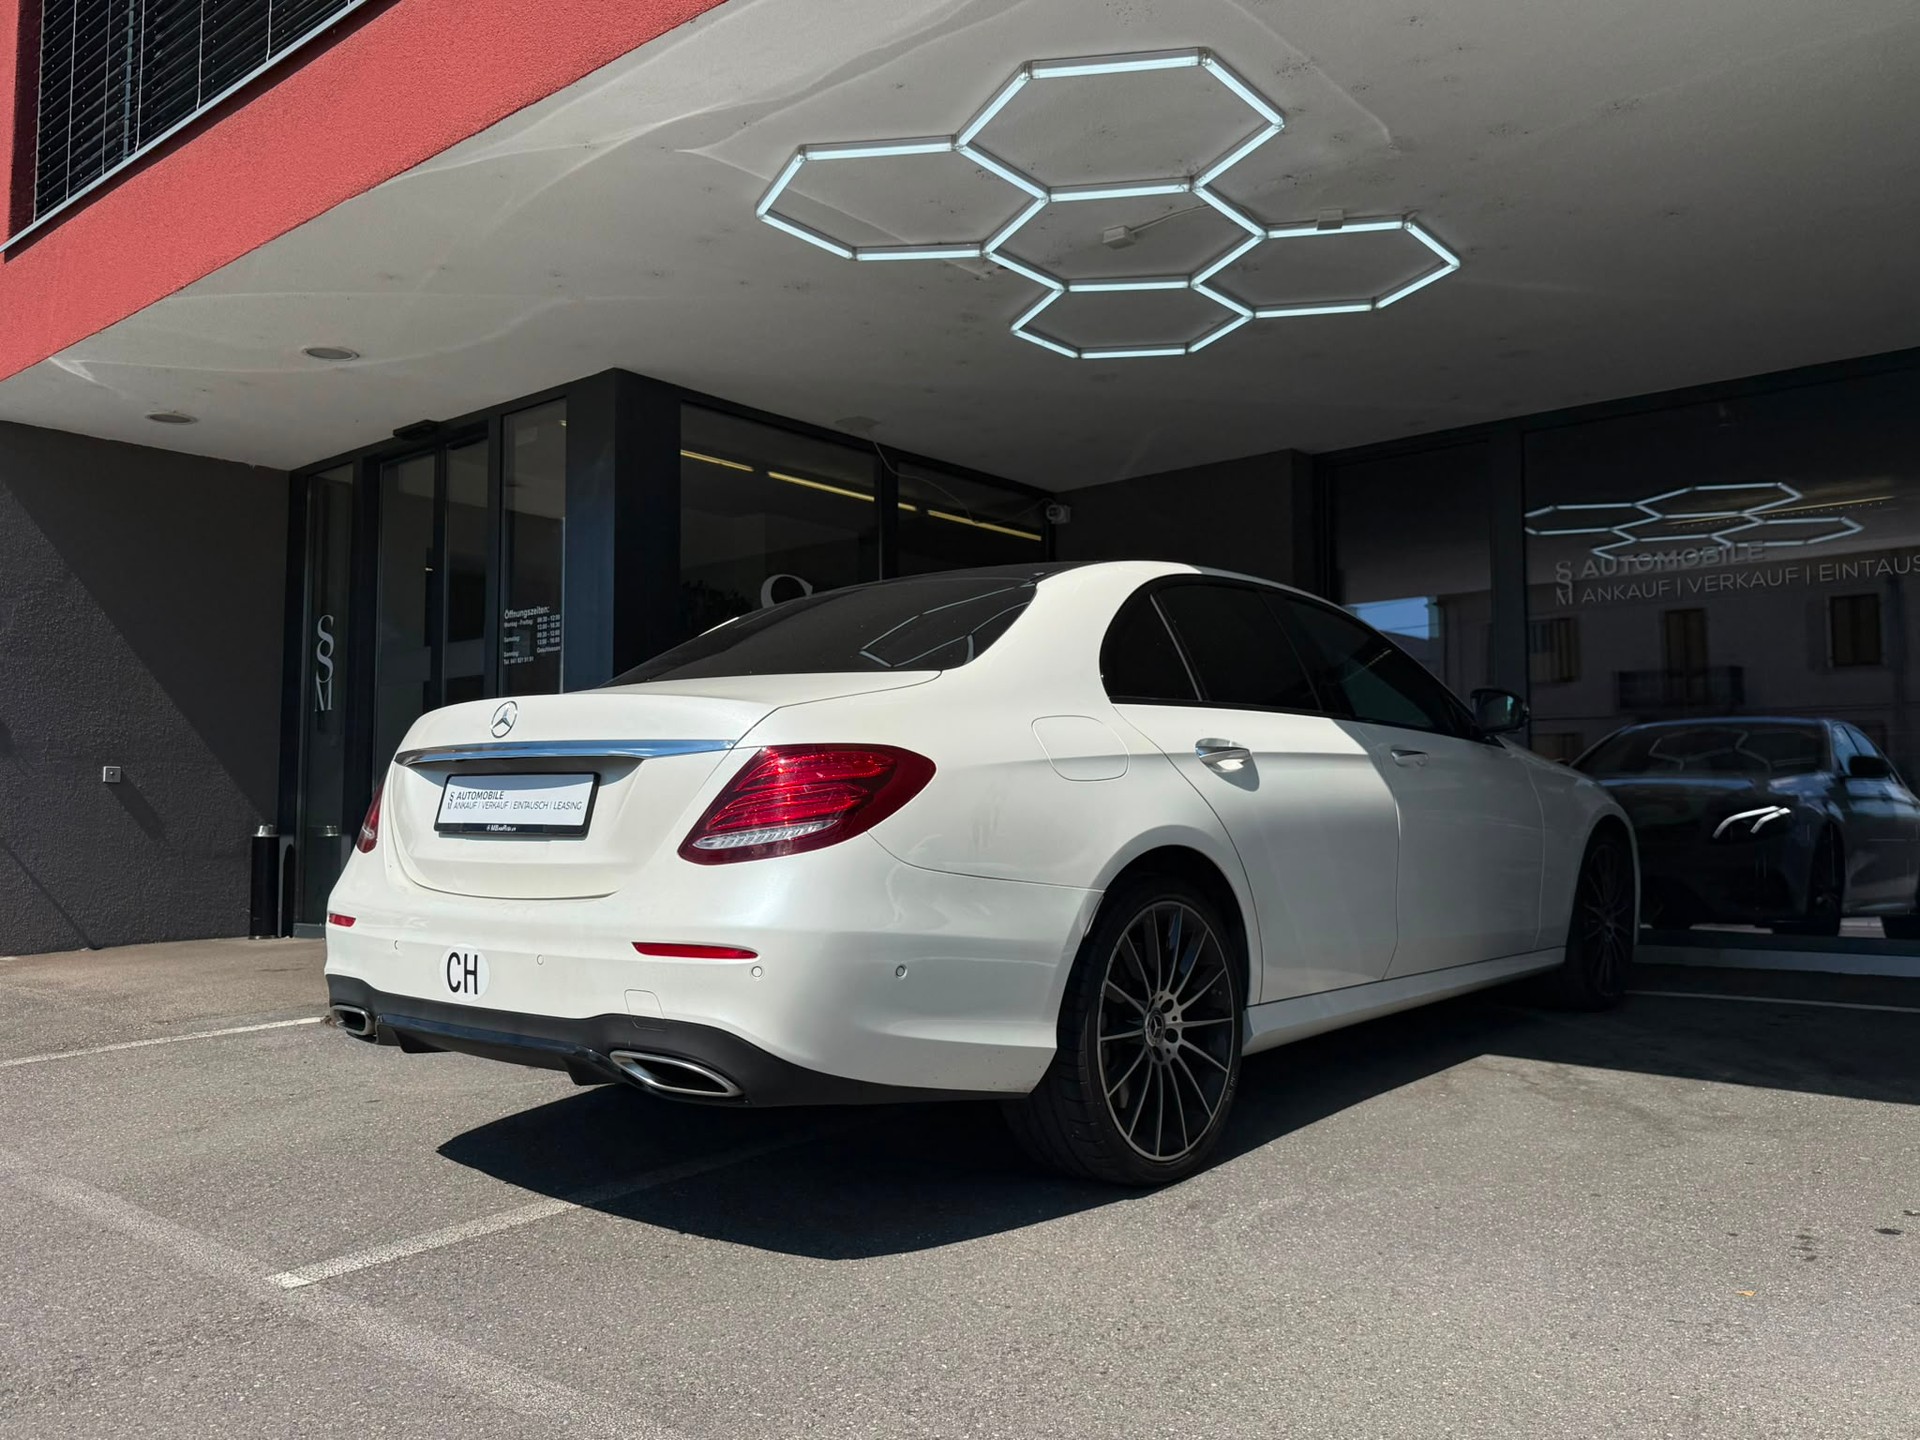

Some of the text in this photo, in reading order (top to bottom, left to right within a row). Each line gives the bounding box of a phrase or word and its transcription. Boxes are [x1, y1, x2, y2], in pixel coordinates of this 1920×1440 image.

[1580, 540, 1766, 580] AUTOMOBILE
[1581, 579, 1672, 603] ANKAUF
[1686, 567, 1800, 592] VERKAUF
[453, 801, 582, 810] ANKAUF VERKAUF EINTAUSCH LEASING
[455, 791, 505, 800] AUTOMOBILE
[446, 951, 478, 995] CH
